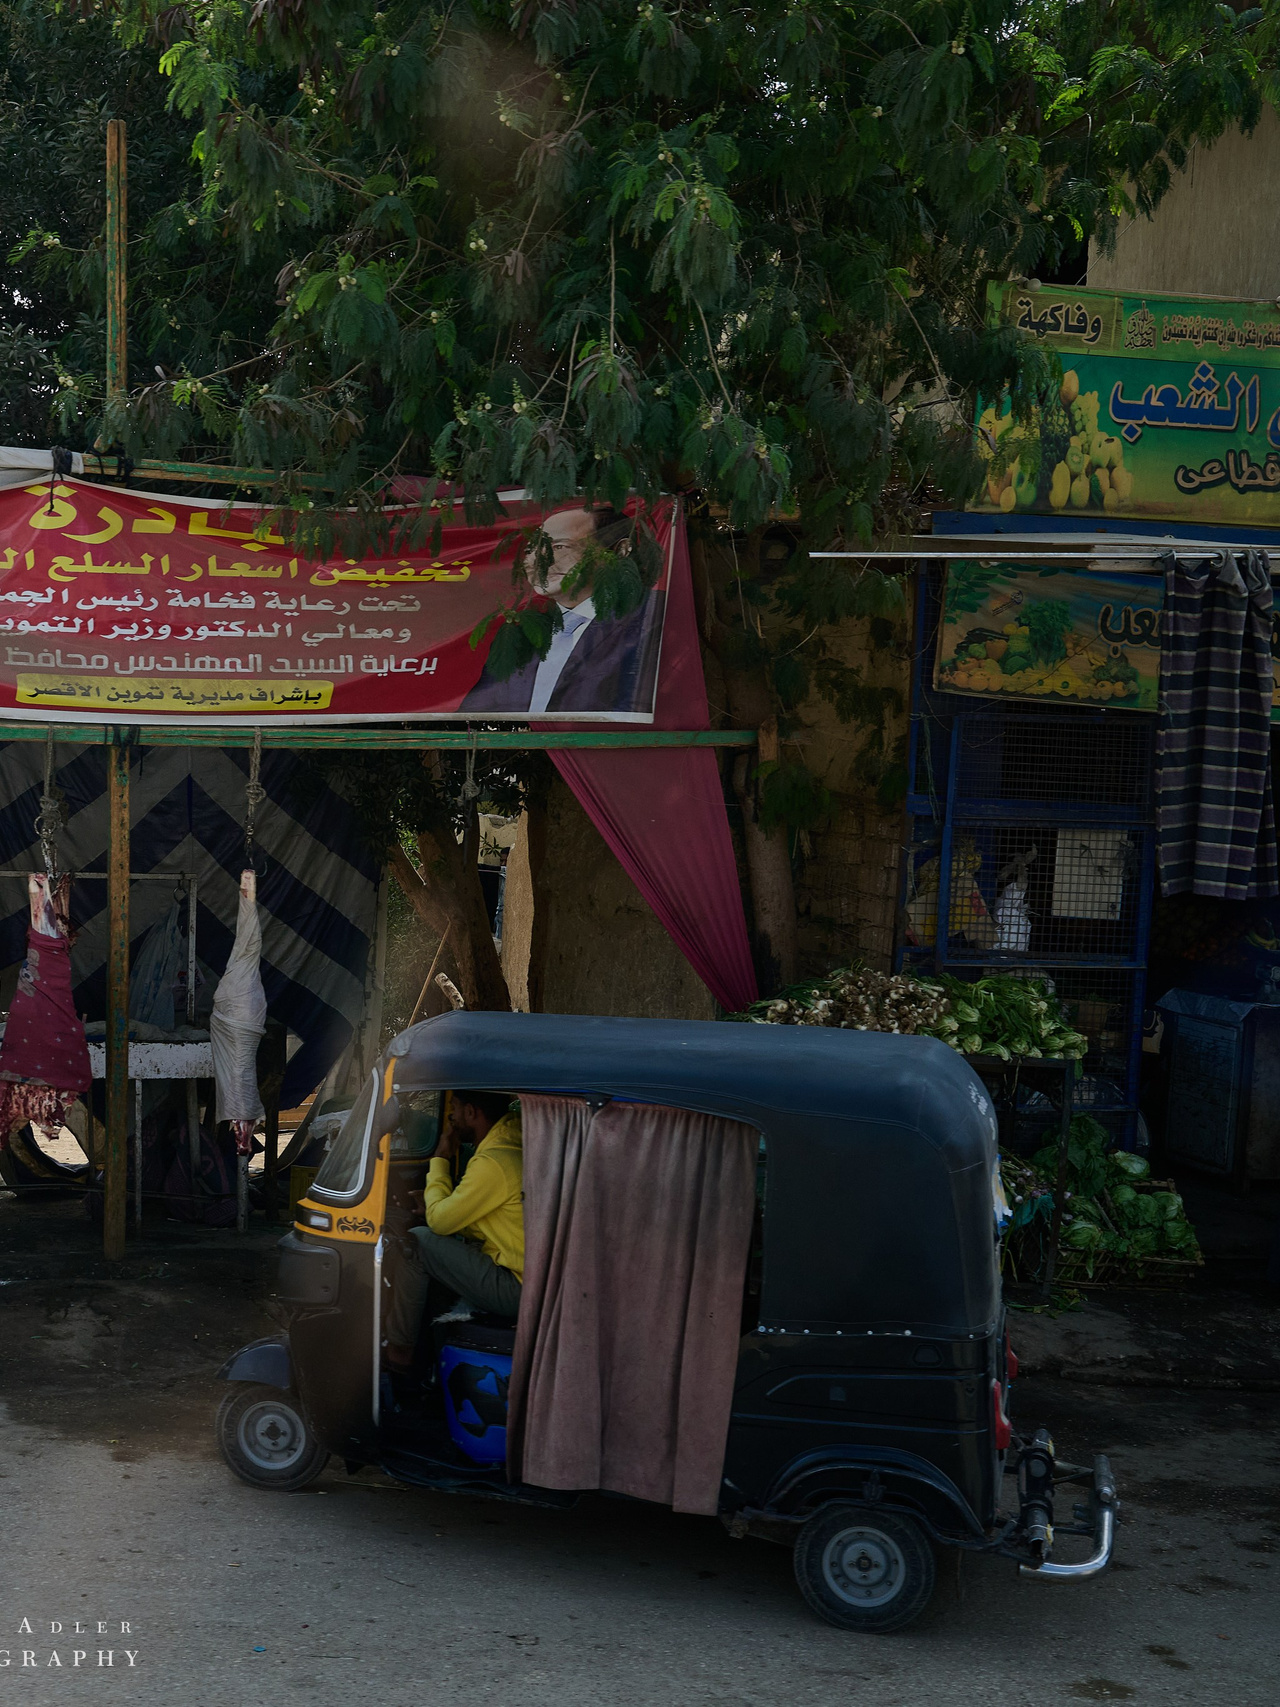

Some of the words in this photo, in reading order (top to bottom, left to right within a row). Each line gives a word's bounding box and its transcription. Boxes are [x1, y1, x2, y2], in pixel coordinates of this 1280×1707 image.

[1017, 297, 1103, 345] وفاكهة
[1109, 360, 1260, 443] الشعب
[24, 485, 318, 552] بادرة
[48, 551, 169, 582] السلع
[174, 554, 298, 582] اسعار
[309, 558, 473, 588] تخفيض
[76, 588, 159, 612] رئيس
[165, 589, 256, 610] فخامة
[262, 591, 351, 616] رعاية
[358, 594, 421, 612] تحت
[100, 618, 172, 641] وزير
[173, 619, 293, 641] الدكتور
[301, 622, 412, 647] ومعالي
[4, 646, 109, 670] محافظ
[114, 652, 262, 675] المهندس
[270, 654, 354, 677] السيد
[360, 655, 438, 677] برعاية
[107, 686, 165, 703] تموين
[170, 686, 244, 705] مديرية
[249, 687, 322, 705] بإشراف
